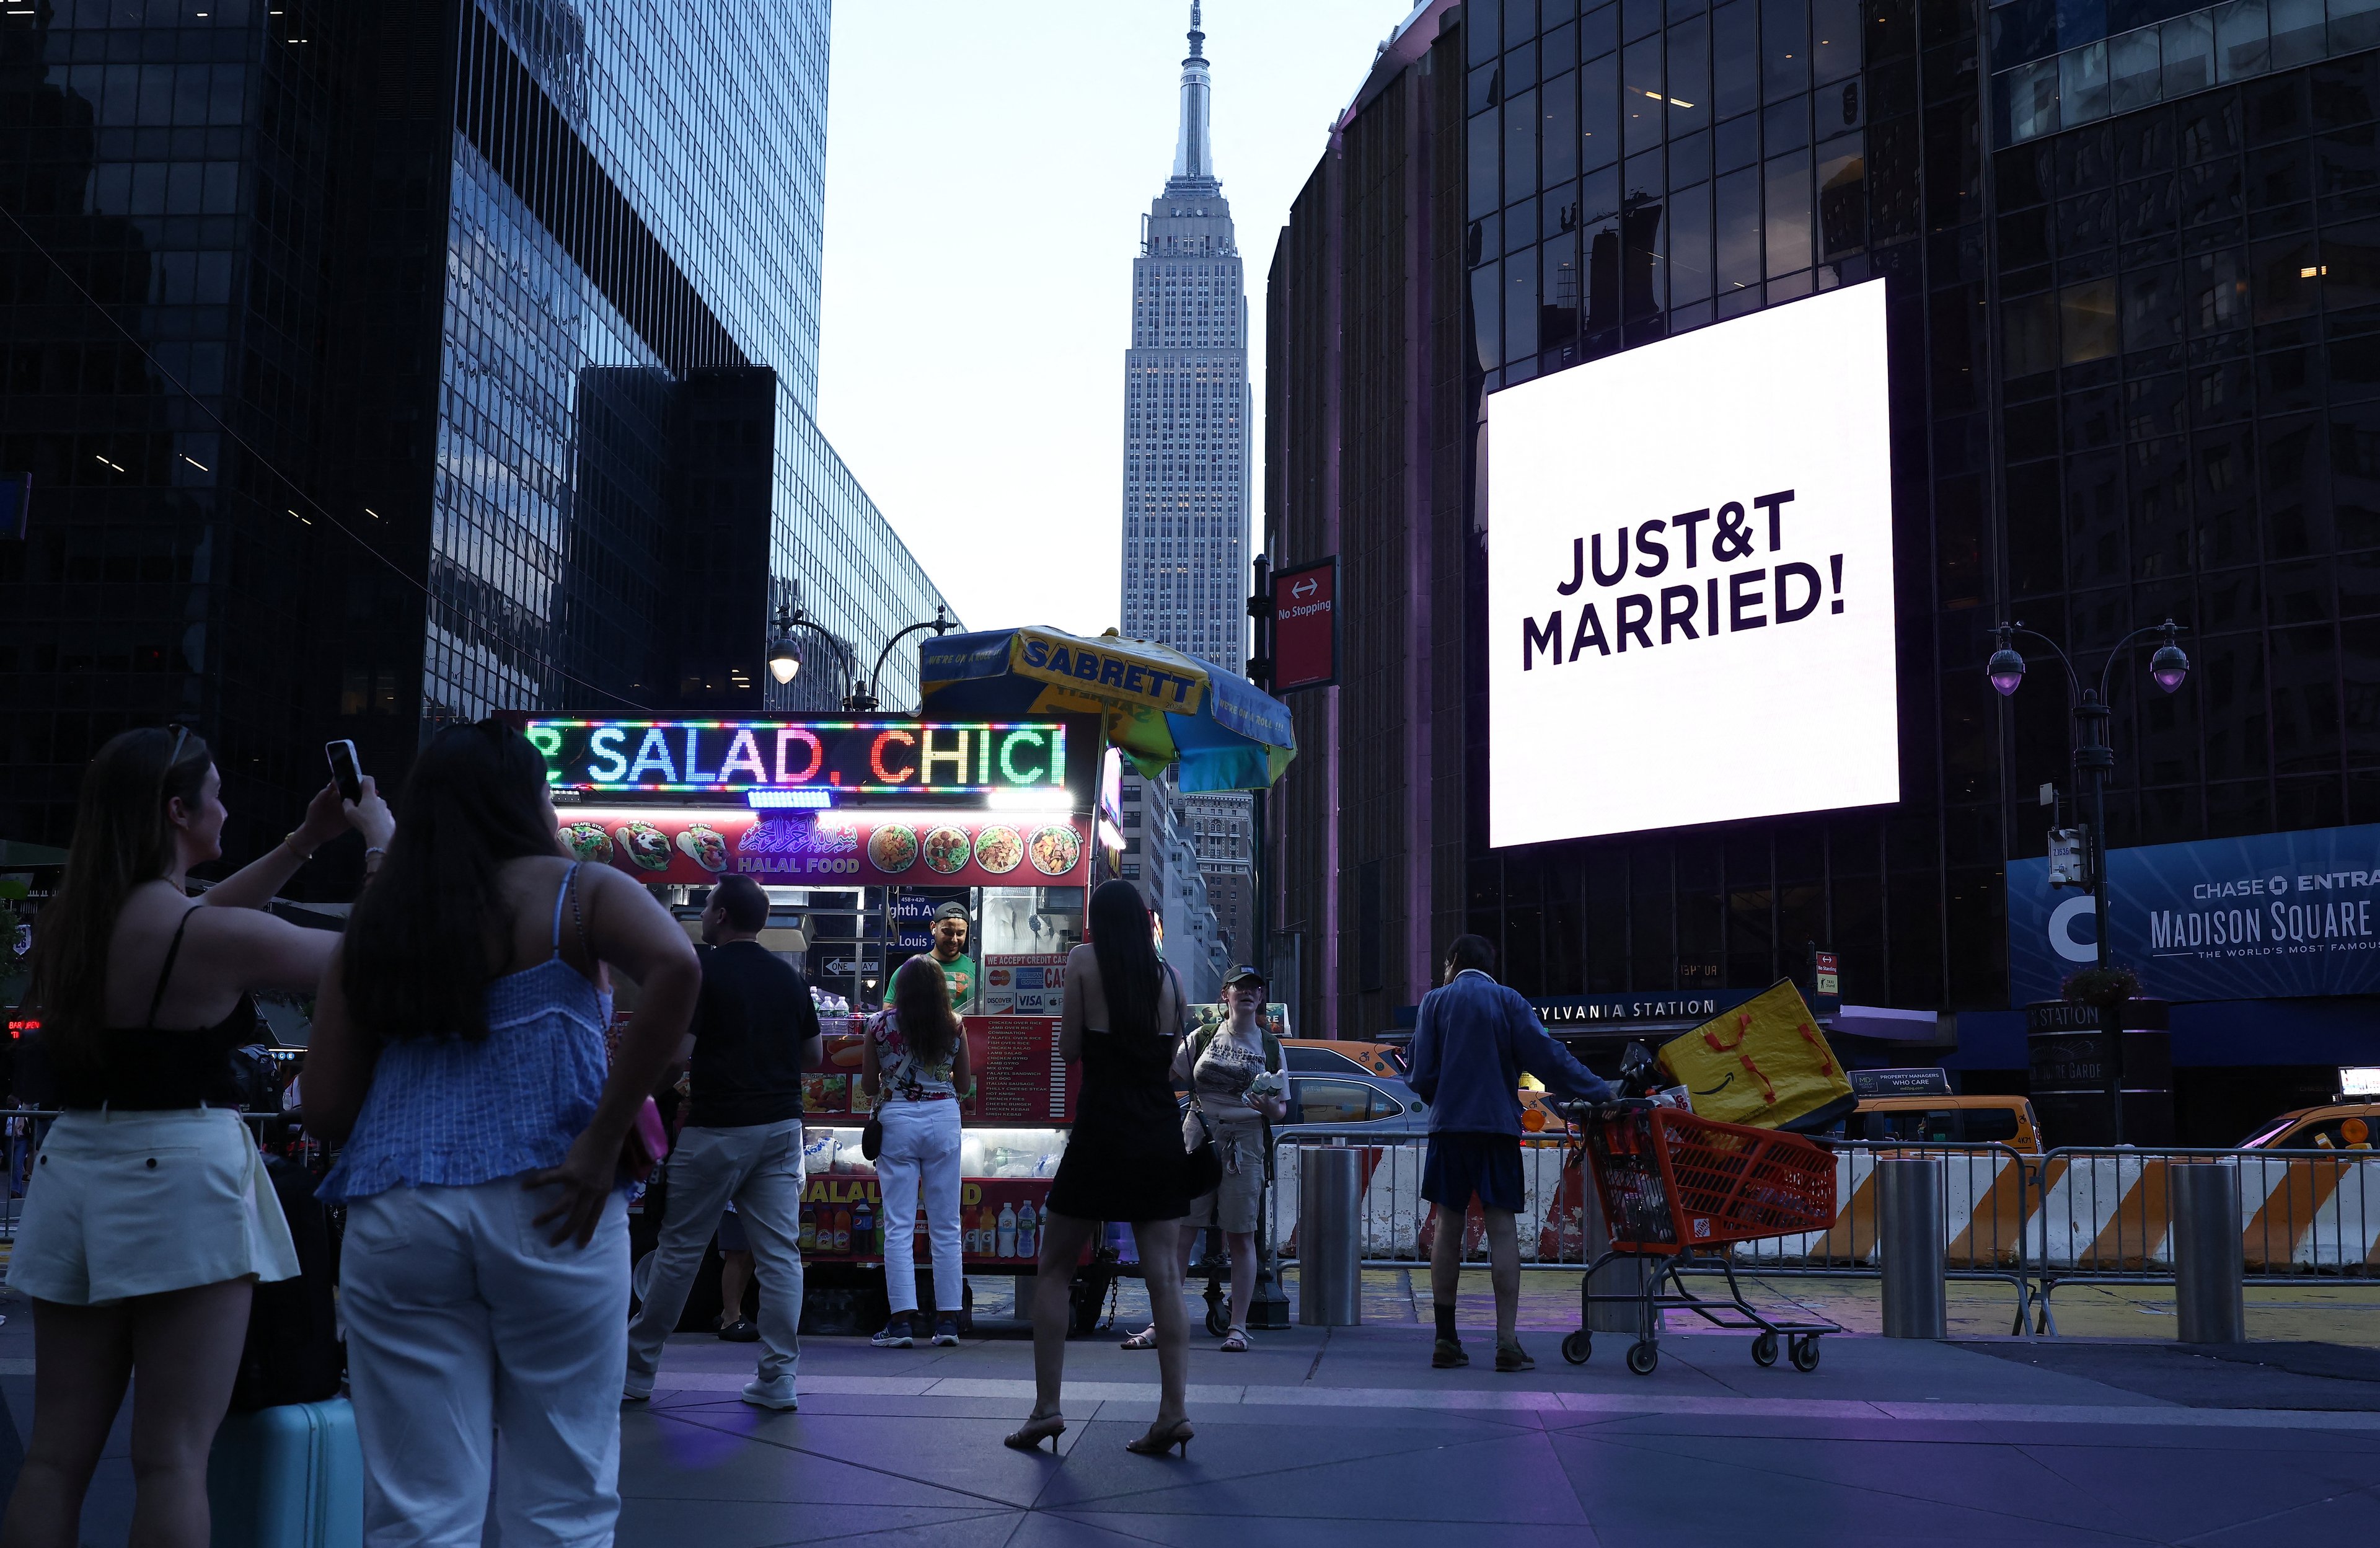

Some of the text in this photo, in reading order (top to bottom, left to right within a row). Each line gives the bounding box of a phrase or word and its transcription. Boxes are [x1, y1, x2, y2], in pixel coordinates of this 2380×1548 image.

[1557, 489, 1795, 596] JUST&T
[1279, 599, 1331, 620] No Stopping
[1523, 554, 1845, 671] MARRIED!
[1022, 637, 1196, 702] SABRETT
[1219, 699, 1238, 715] WE'RE
[1238, 709, 1248, 719] ON
[1250, 713, 1254, 722] A
[1256, 715, 1272, 728] ROLL
[588, 728, 839, 786] SALAD,
[871, 730, 1060, 784] CHIC
[592, 823, 605, 832] GYRO
[641, 820, 654, 828] GYRO
[961, 825, 972, 836] RICE
[1062, 822, 1077, 833] OVER
[1075, 831, 1084, 844] RICE
[738, 858, 860, 873] HALAL FOOD
[2193, 869, 2380, 900] CHASE ENTRA
[879, 903, 918, 918] ghth
[2151, 901, 2373, 949] MADISON SQUARE
[899, 935, 927, 947] Louis
[987, 955, 1068, 965] WE ACCEPT CREDIT CAR
[2198, 950, 2221, 959] THE
[2226, 947, 2283, 958] WORLD'S
[2289, 945, 2324, 954] MOST
[1019, 995, 1042, 1006] VISA
[1633, 999, 1714, 1017] STATION
[2040, 1006, 2099, 1027] STATION
